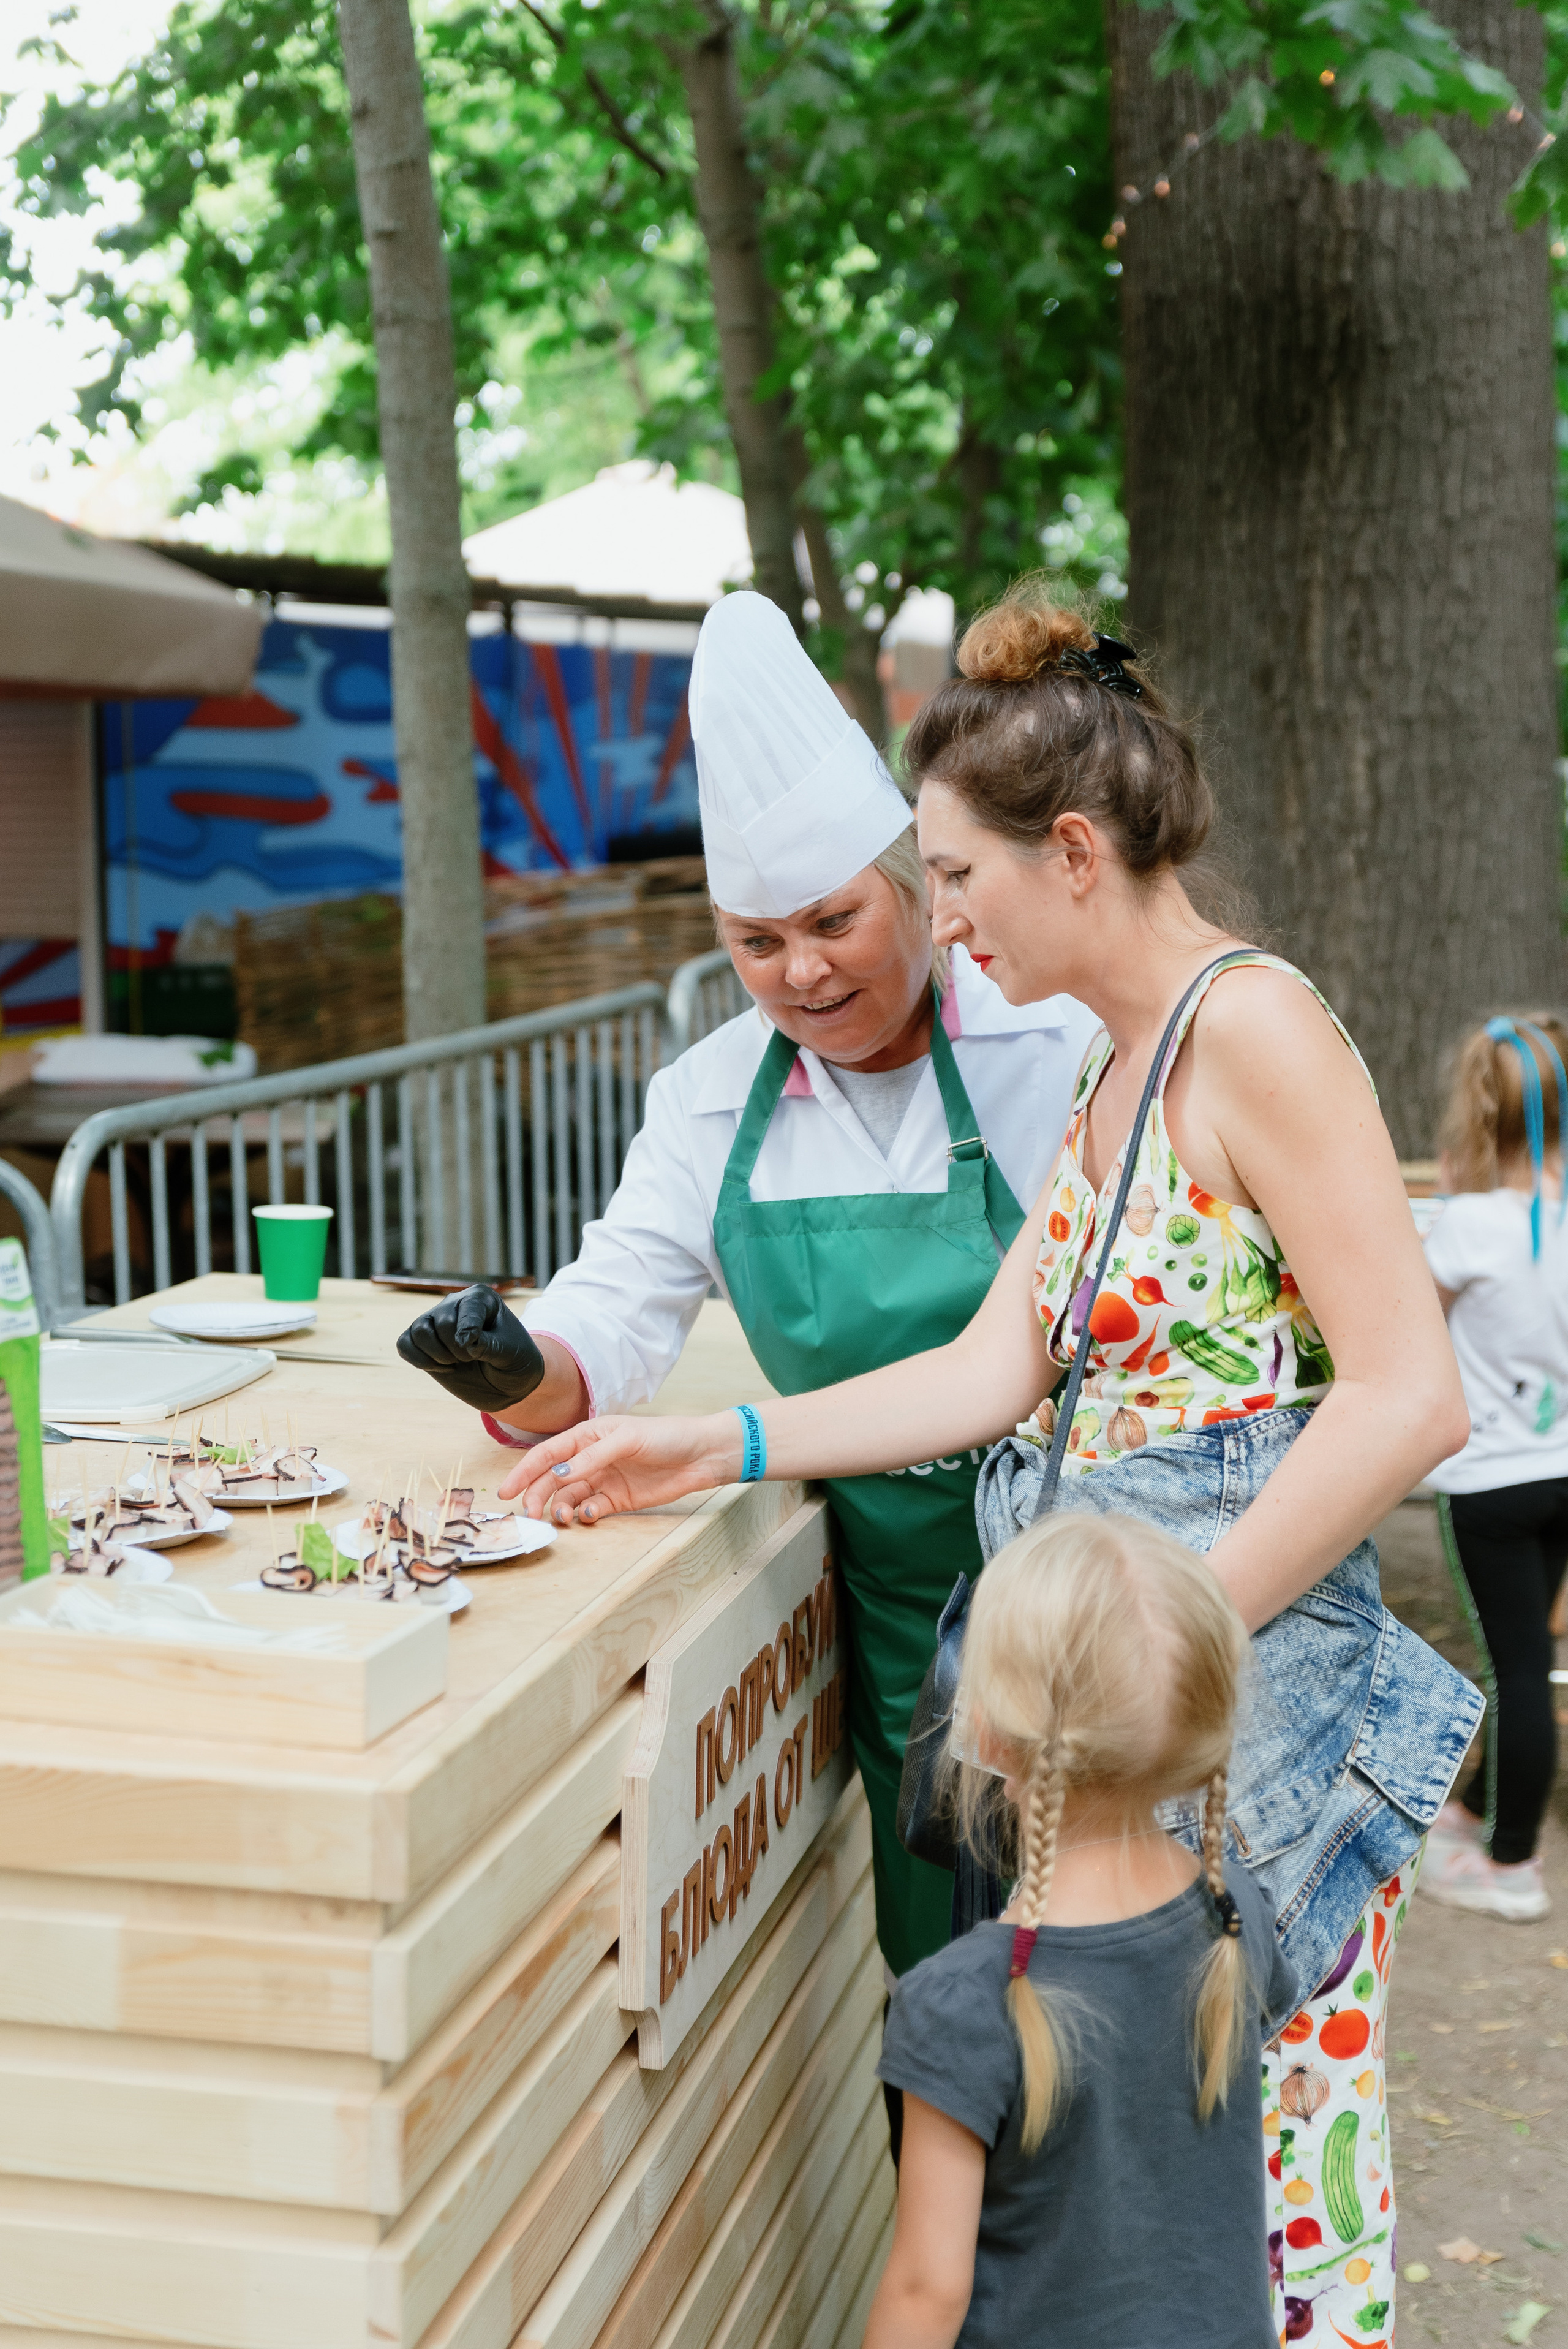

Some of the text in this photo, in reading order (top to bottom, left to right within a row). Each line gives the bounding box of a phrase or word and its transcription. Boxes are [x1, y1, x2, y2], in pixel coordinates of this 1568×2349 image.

[748, 1453, 761, 1473] РОКА
[695, 1551, 842, 1818] ПОПРОБУЙ
[659, 1772, 769, 2005] БЛЮДА
[774, 1714, 809, 1828] ОТ
